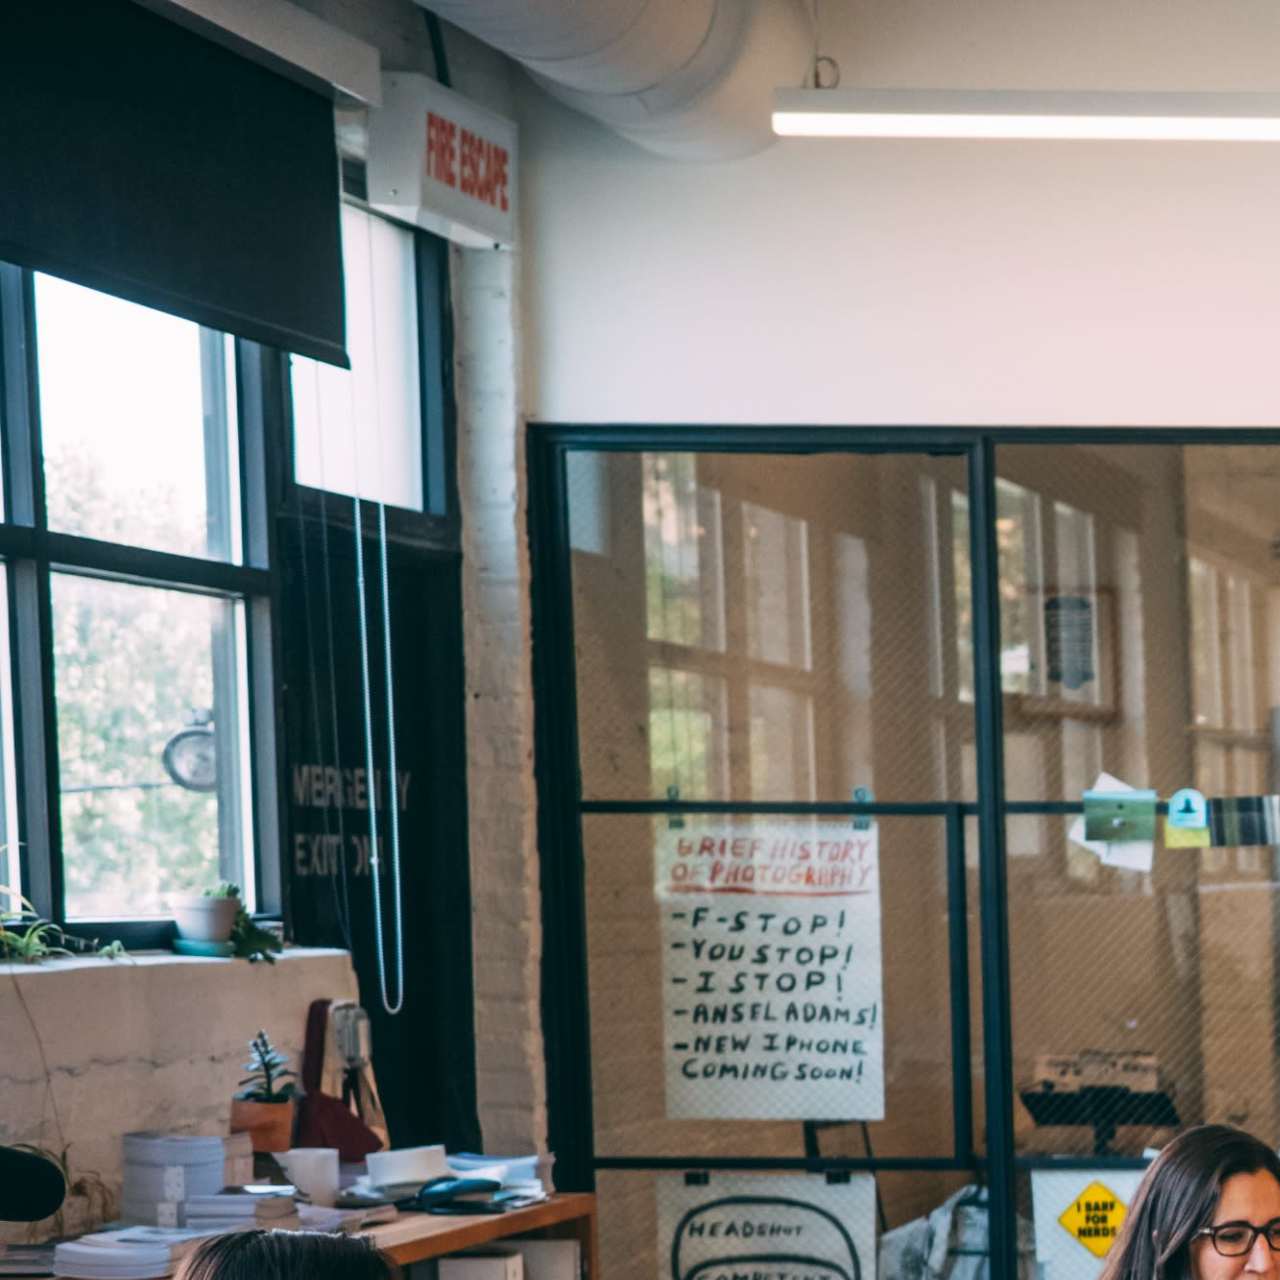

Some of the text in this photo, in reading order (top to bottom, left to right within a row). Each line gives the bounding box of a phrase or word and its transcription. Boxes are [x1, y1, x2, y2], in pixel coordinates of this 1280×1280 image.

[426, 111, 509, 212] FIRE ESCAPE
[769, 838, 870, 862] HISTORY
[670, 859, 871, 886] OF PHOTOGRAPHY
[752, 943, 853, 970] STOP!
[728, 971, 843, 1001] STOP!
[785, 1002, 878, 1030] ADAMS!
[681, 1058, 864, 1083] COMING SOON!
[687, 1221, 804, 1238] HEADSHOT
[1085, 1214, 1108, 1225] FOR
